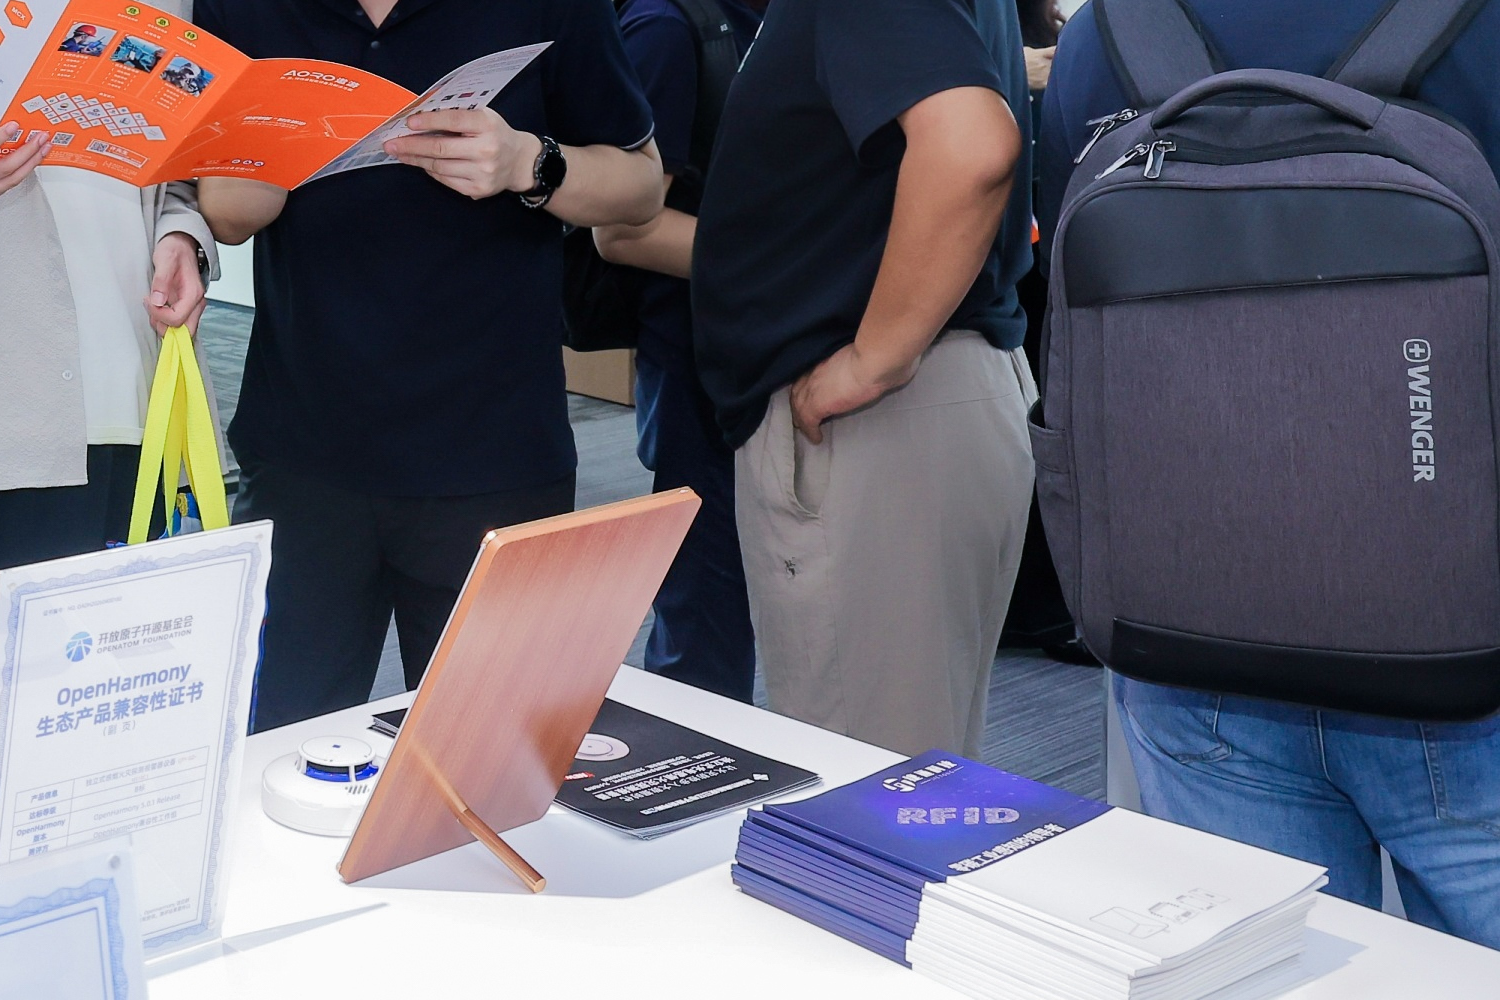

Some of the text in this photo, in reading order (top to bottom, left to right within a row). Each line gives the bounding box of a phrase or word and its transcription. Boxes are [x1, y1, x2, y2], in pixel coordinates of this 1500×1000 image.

[1407, 364, 1435, 483] WENGER
[96, 628, 192, 655] OPENATOM FOUNDATION
[97, 614, 194, 645] 开放原子开源基金会
[56, 662, 191, 708] OpenHarmony
[35, 681, 204, 739] 生态产品兼容性证书
[16, 818, 66, 837] OpenHarmony
[896, 806, 1021, 825] RFID
